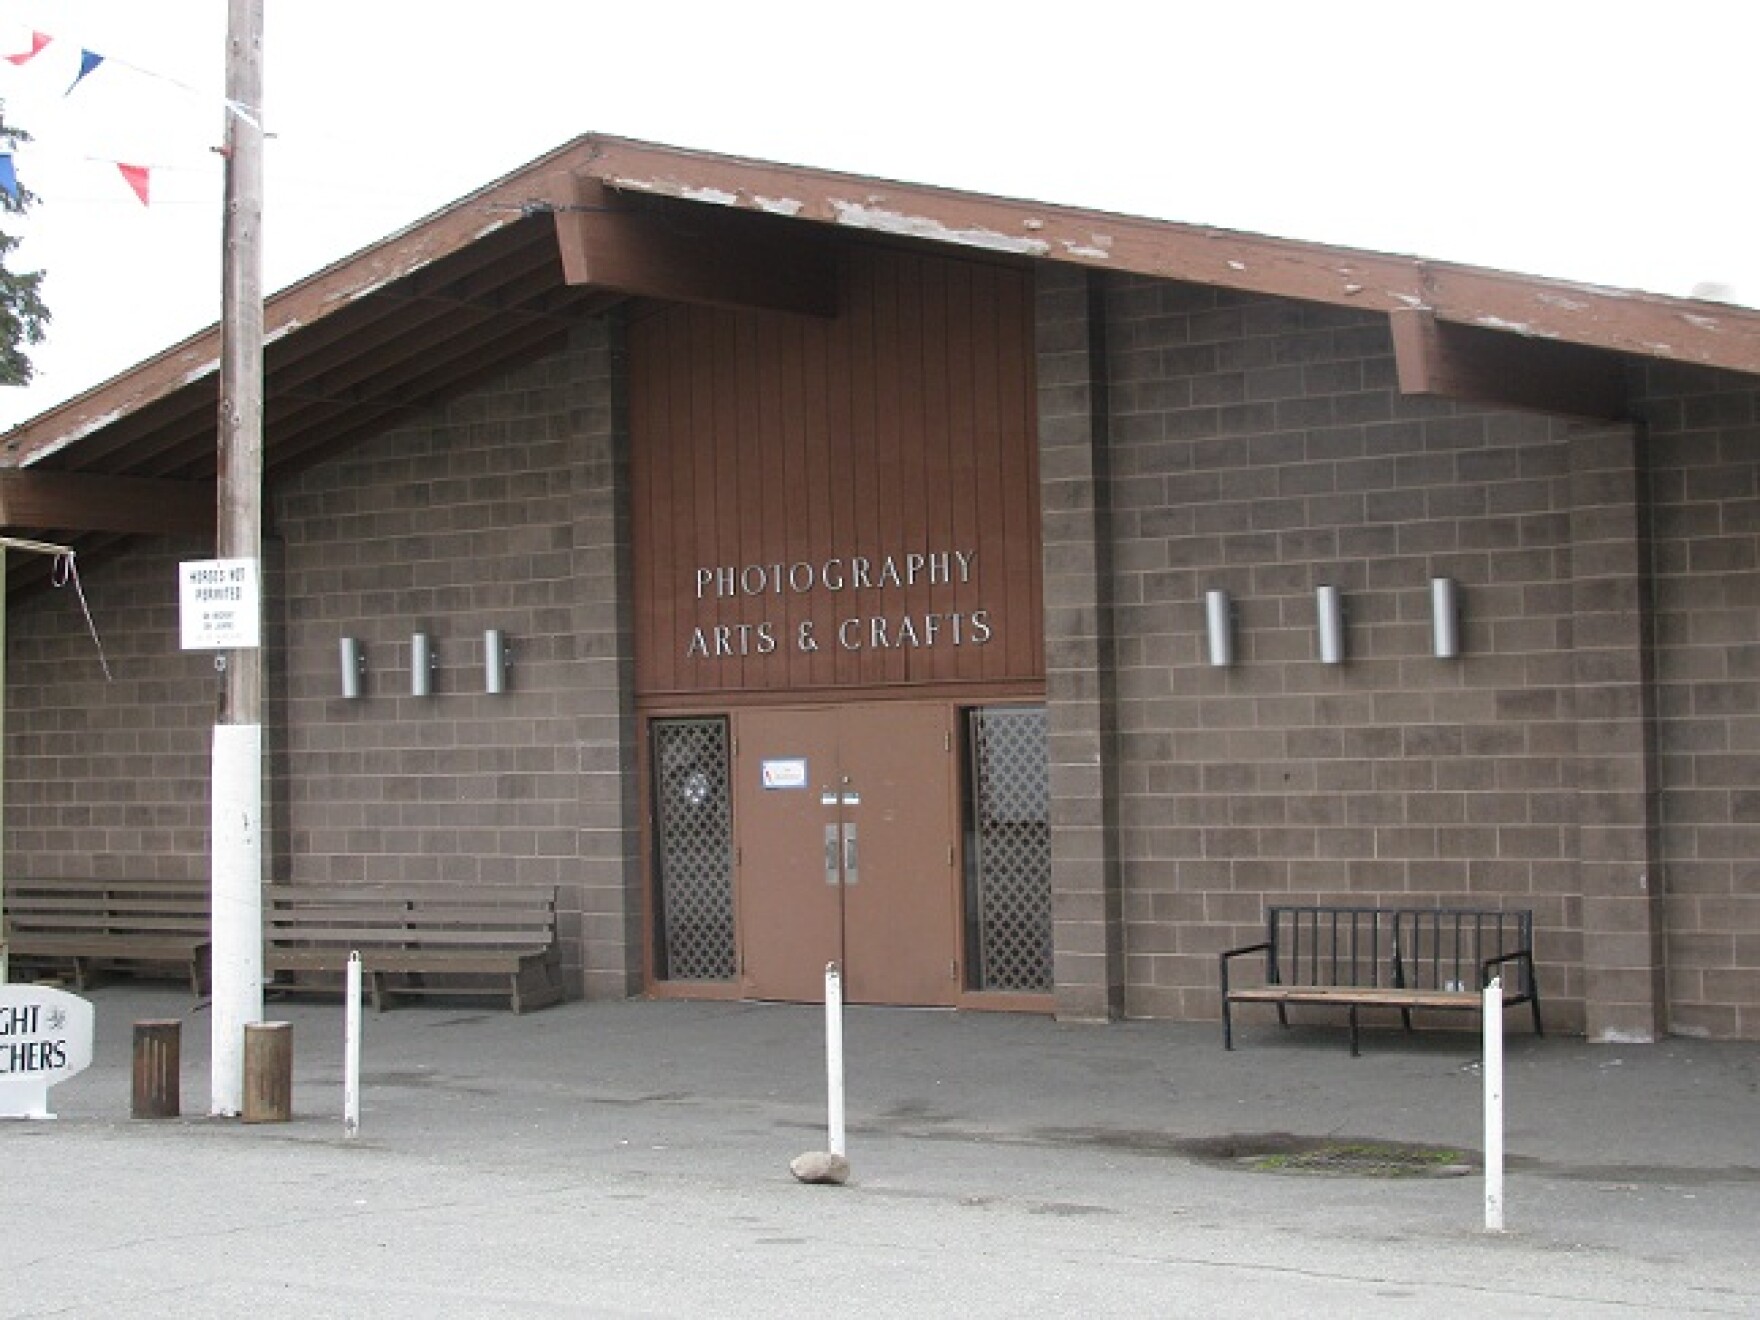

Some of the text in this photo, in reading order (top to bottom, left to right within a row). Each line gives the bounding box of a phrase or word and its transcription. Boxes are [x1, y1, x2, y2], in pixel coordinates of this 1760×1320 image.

[697, 550, 975, 599] PHOTOGRAPHY
[686, 610, 993, 658] ARTS & CRAFTS
